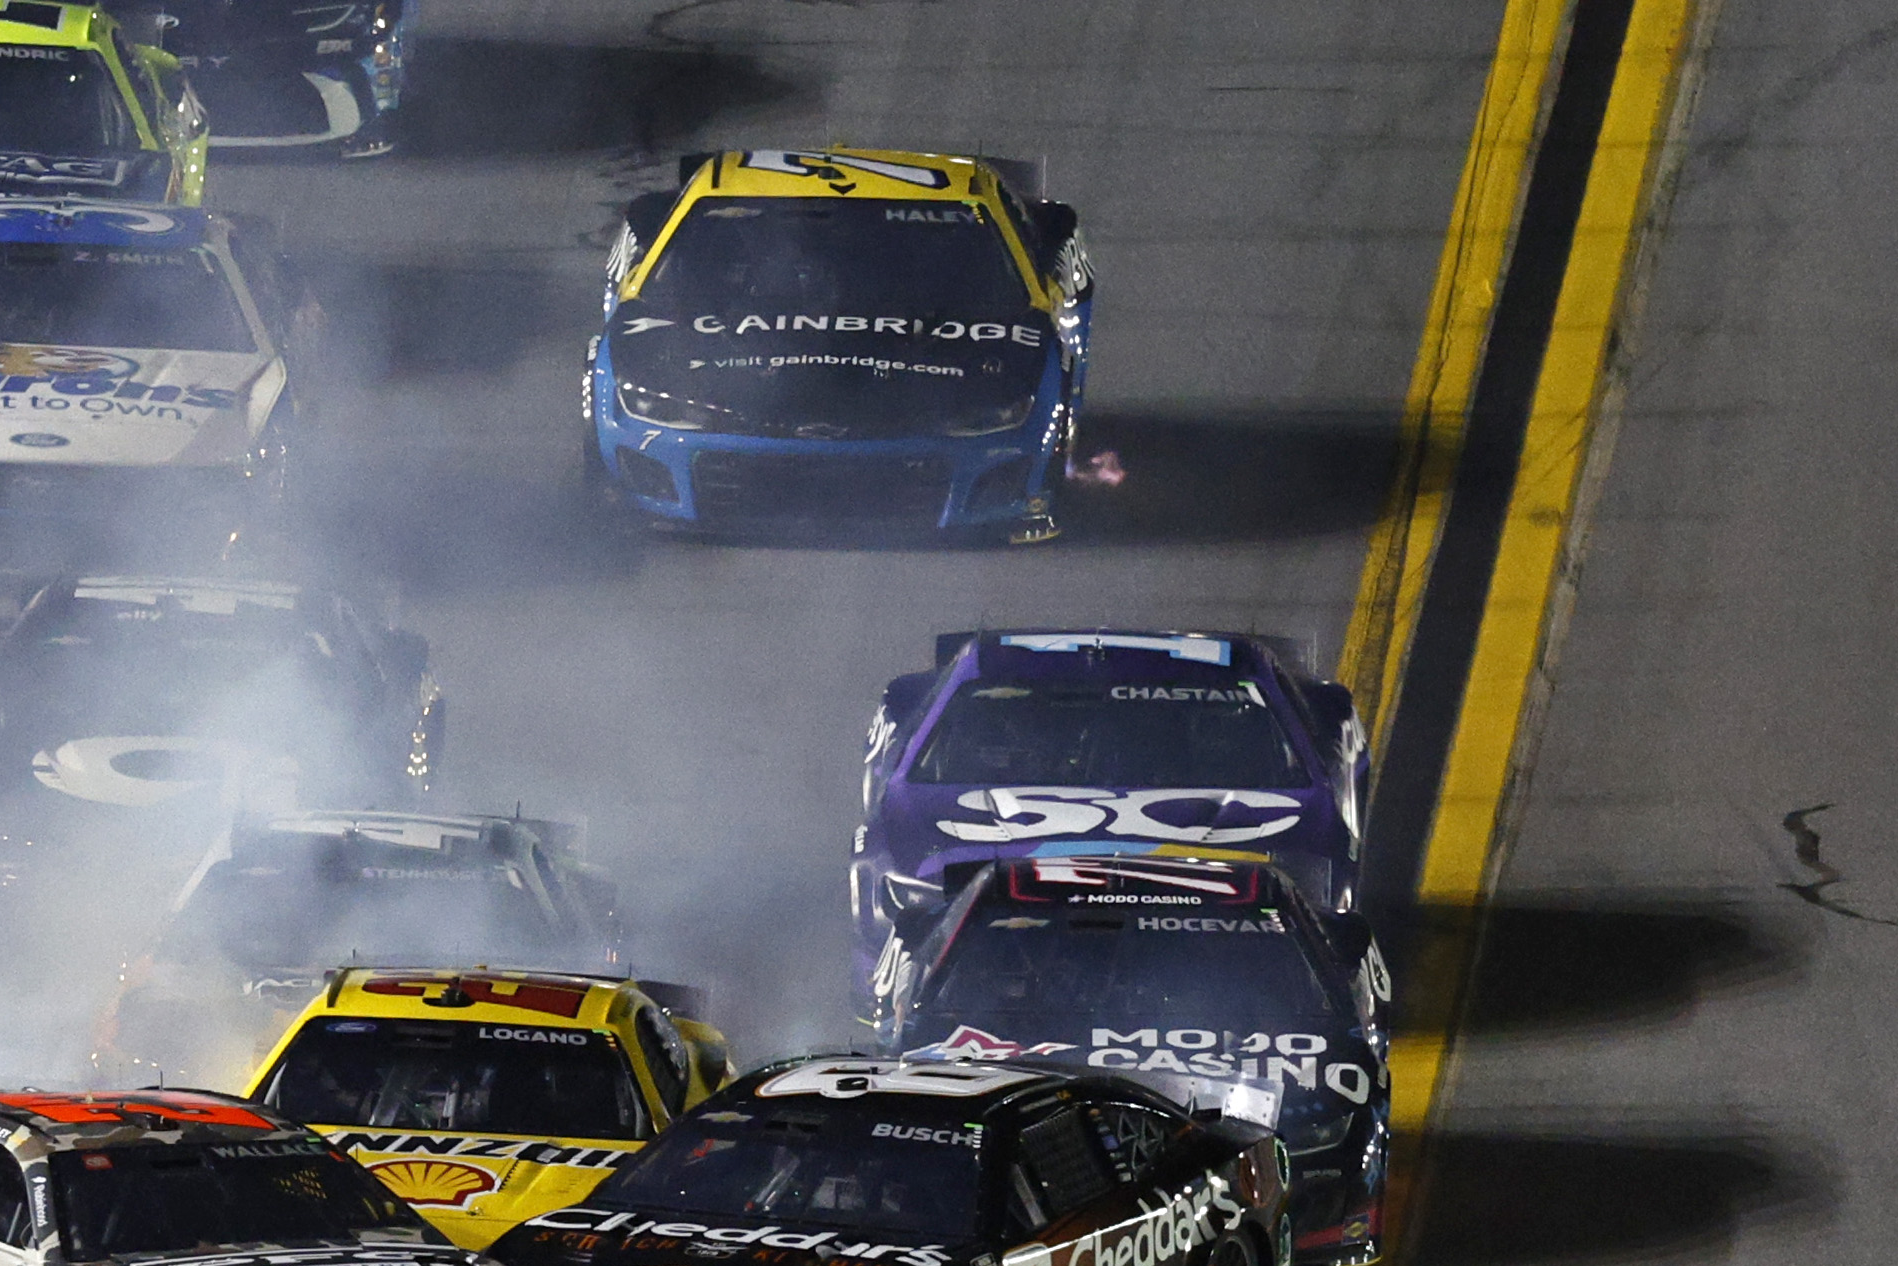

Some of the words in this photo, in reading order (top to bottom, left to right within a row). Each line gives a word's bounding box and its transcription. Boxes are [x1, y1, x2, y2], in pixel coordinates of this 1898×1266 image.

[885, 208, 974, 227] HALEY
[693, 315, 1042, 348] GAINBRIDGE
[714, 355, 763, 369] visit
[768, 354, 965, 377] gainbridge.com
[31, 396, 73, 412] to
[78, 397, 184, 422] Own
[638, 430, 664, 451] 7
[1110, 686, 1254, 702] CHASTAIN
[1088, 894, 1138, 904] MODO
[1140, 895, 1203, 905] CASINO
[1137, 917, 1278, 934] HOCEVAR
[478, 1027, 589, 1047] LOGANO
[871, 1122, 974, 1147] BUSCH
